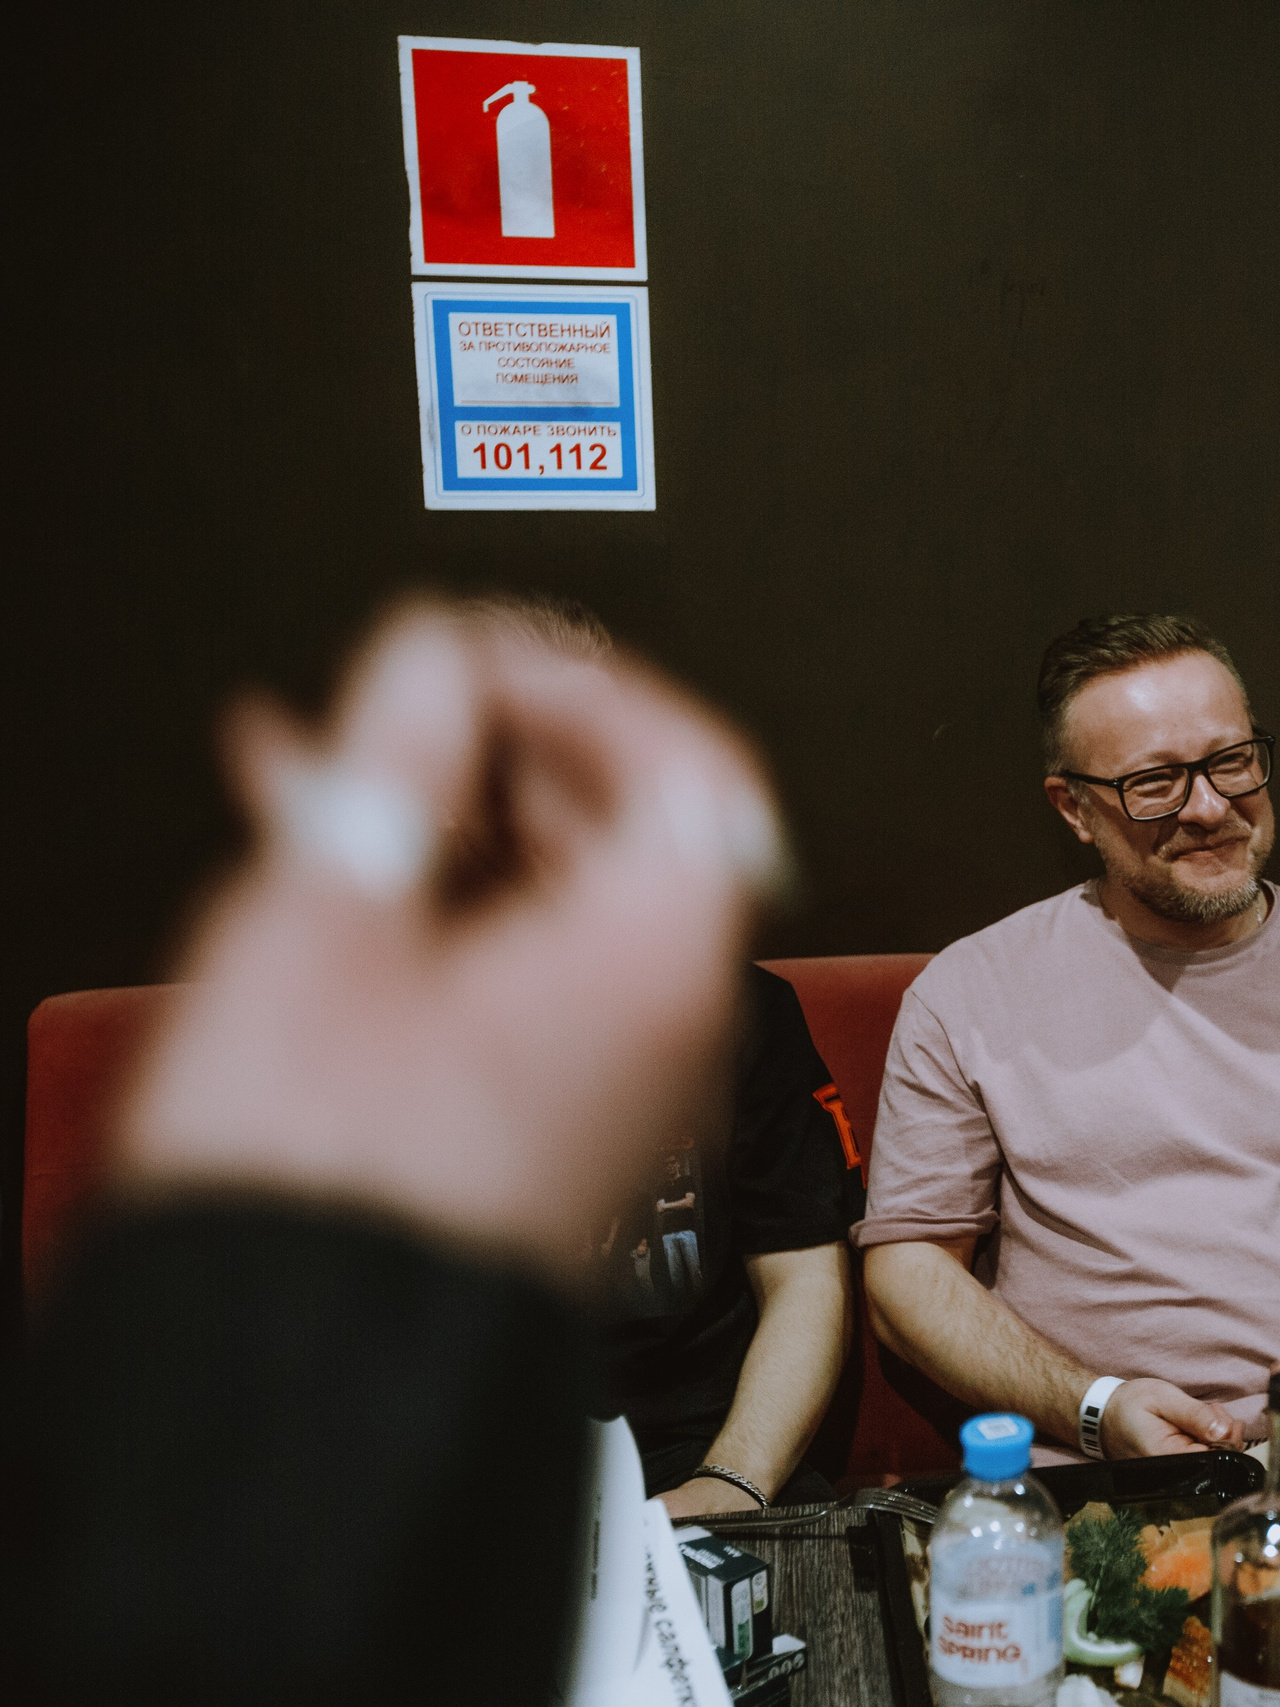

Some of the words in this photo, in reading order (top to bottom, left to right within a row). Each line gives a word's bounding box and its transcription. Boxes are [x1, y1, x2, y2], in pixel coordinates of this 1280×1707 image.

[458, 320, 611, 339] ОТВЕТСТВЕННЫЙ
[459, 340, 475, 352] ЗА
[479, 340, 611, 354] ПРОТИВОПОЖАРНОЕ
[497, 357, 576, 369] СОСТОЯНИЕ
[495, 372, 579, 386] ПОМЕЩЕНИЯ
[461, 424, 472, 436] О
[477, 424, 542, 437] ПОЖАРЕ
[547, 425, 617, 438] ЗВОНИТЬ
[473, 442, 608, 476] 101,112
